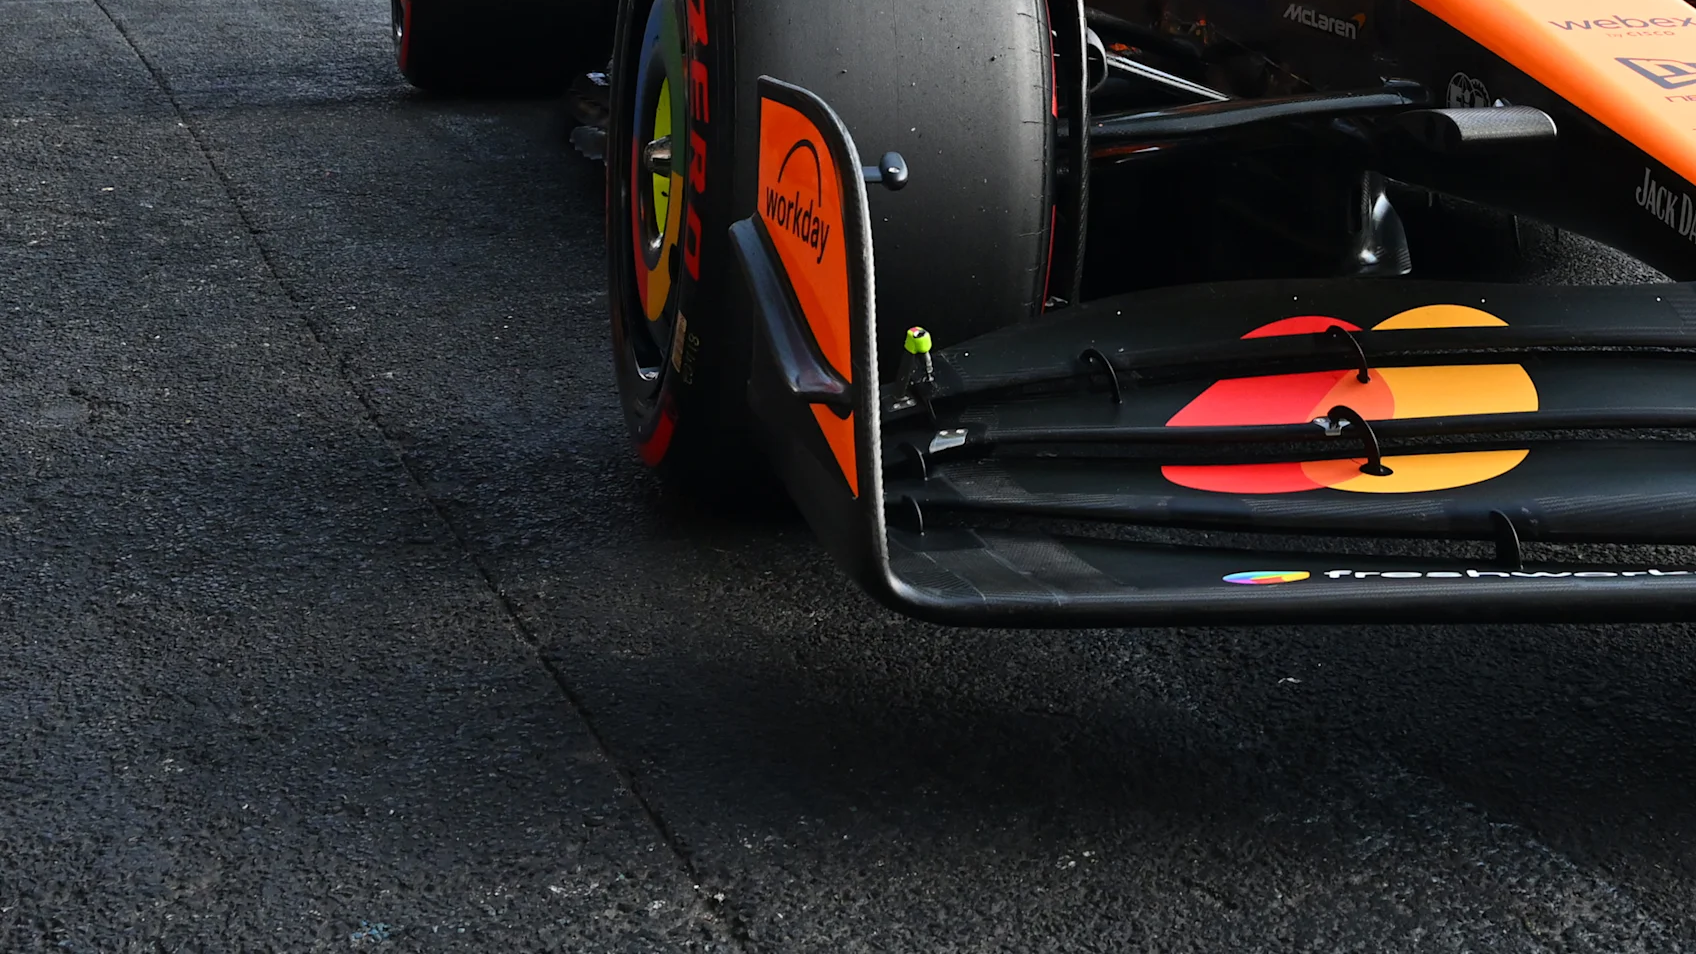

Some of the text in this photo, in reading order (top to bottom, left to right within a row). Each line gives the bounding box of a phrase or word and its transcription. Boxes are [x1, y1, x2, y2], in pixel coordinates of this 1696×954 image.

[1283, 3, 1359, 40] McLaren
[765, 188, 831, 265] workday
[1635, 166, 1679, 232] JACK
